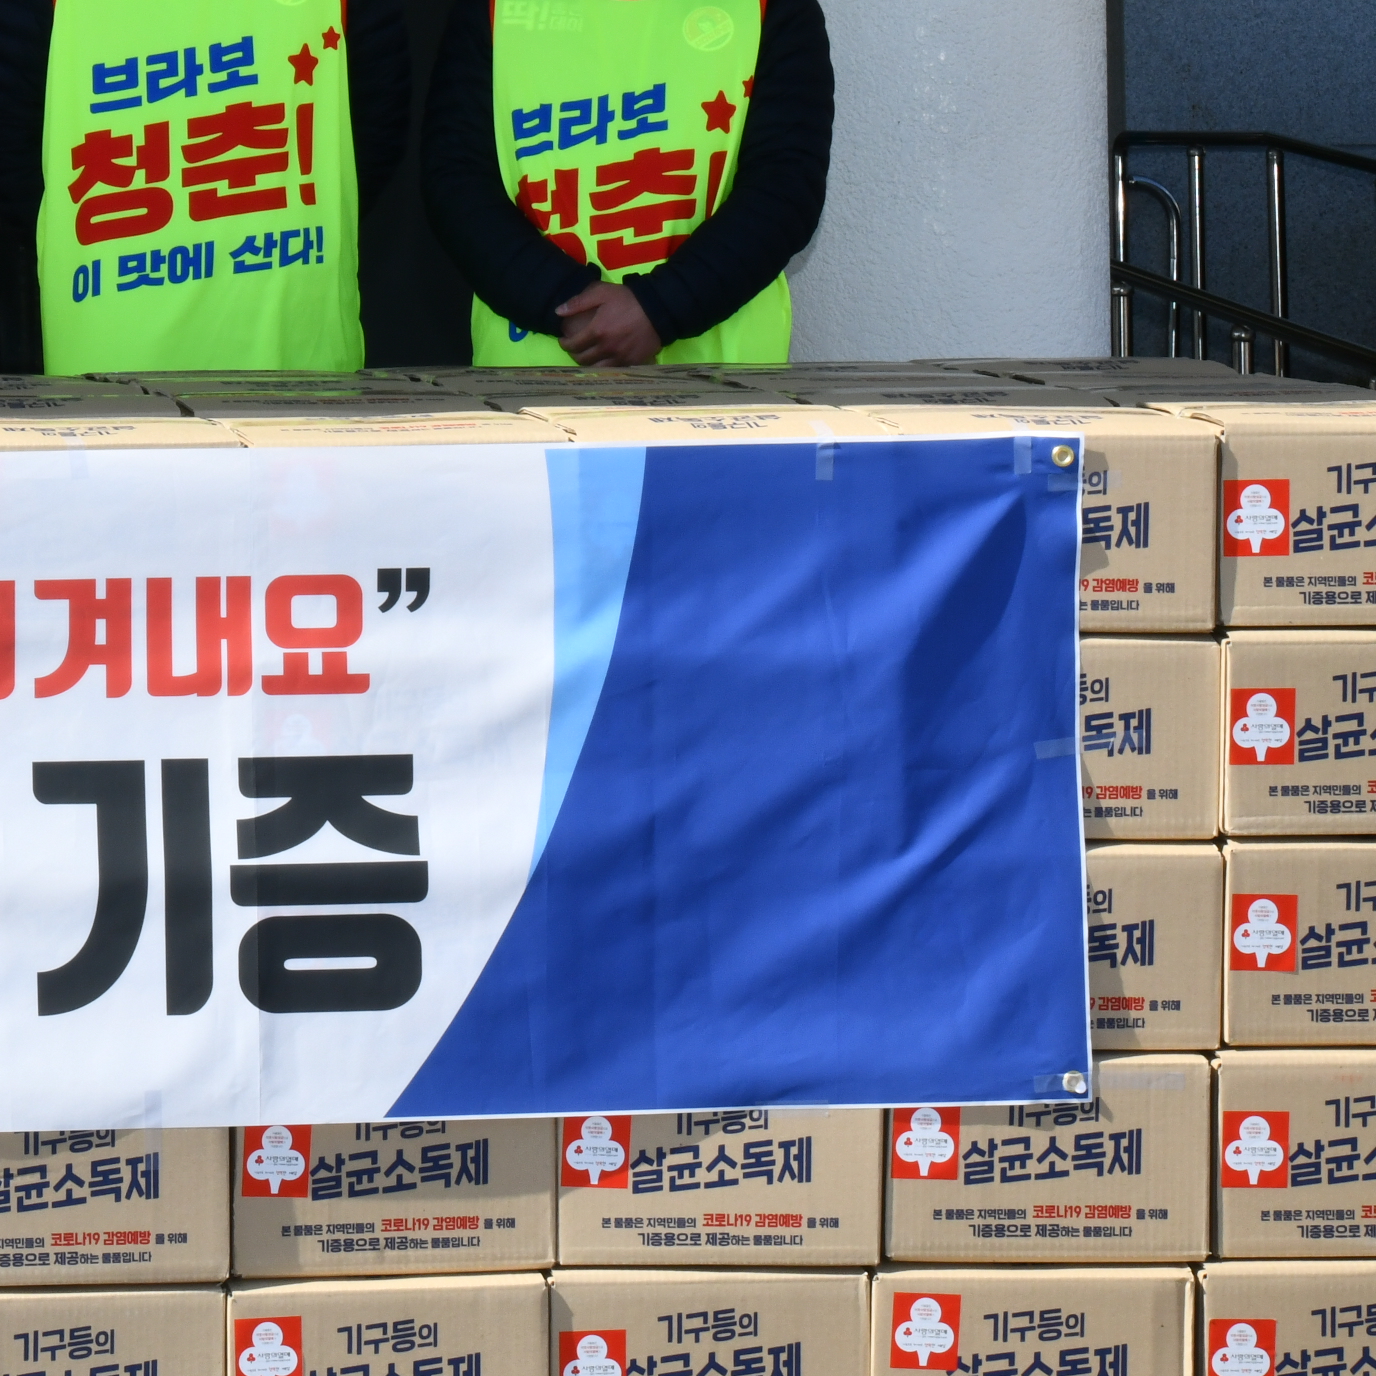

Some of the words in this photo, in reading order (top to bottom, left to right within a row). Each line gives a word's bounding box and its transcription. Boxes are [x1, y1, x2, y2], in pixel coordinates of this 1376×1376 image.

[89, 35, 259, 114] 브라보
[511, 83, 669, 161] 브라보
[67, 101, 317, 245] 청춘!
[72, 259, 101, 303] 이
[116, 241, 214, 293] 맛에
[228, 226, 325, 275] 산다!
[1092, 578, 1139, 593] 감염예방
[1155, 582, 1175, 594] 위해
[31, 753, 429, 1019] 기증
[310, 1136, 490, 1202] 살균소독제
[630, 1133, 813, 1194] 살균소독제
[961, 1127, 1143, 1186] 살균소독제
[602, 1217, 611, 1229] 본
[614, 1217, 644, 1229] 물품은
[647, 1217, 696, 1229] 지역민들의
[702, 1213, 752, 1229] 코로나19
[755, 1213, 803, 1229] 감염예방
[819, 1217, 839, 1228] 위해
[638, 1233, 702, 1247] 기증용으로
[705, 1233, 750, 1247] 제공하는
[753, 1234, 803, 1246] 물품입니다
[337, 1319, 437, 1355] 기구등의
[658, 1309, 758, 1344] 기구등의
[984, 1309, 1084, 1342] 기구등의
